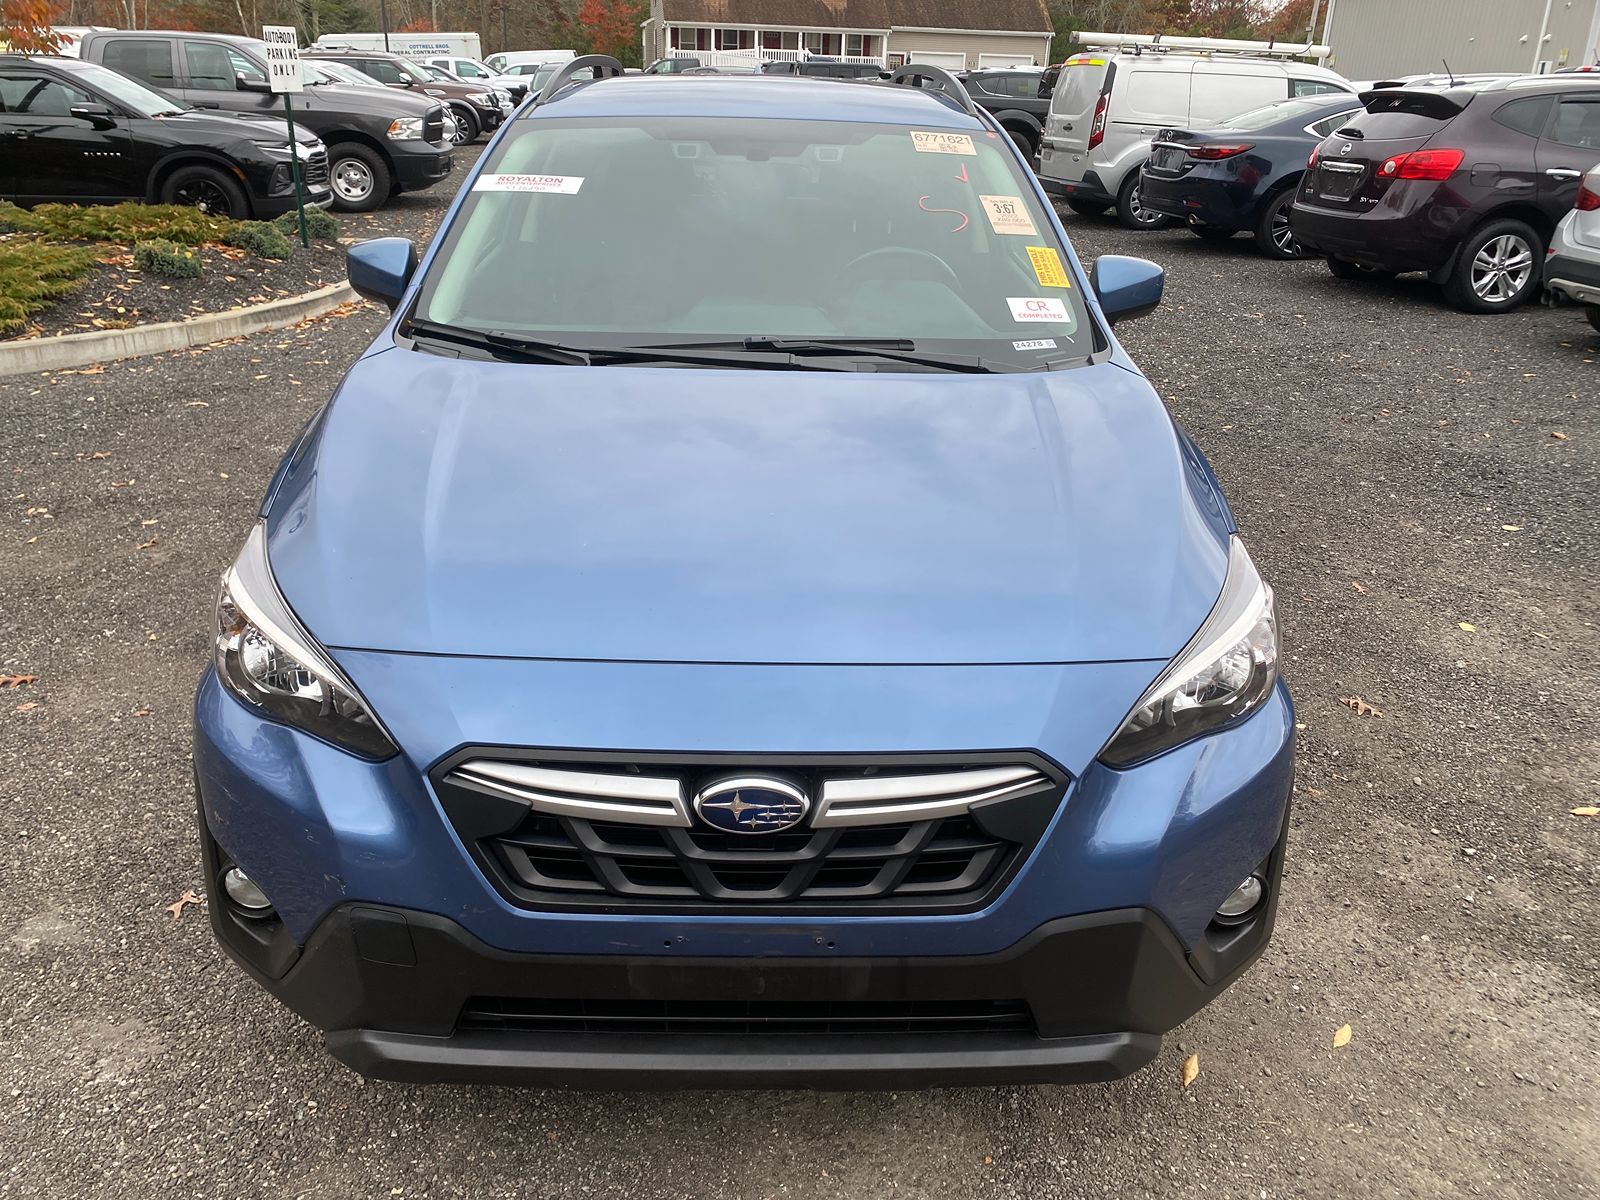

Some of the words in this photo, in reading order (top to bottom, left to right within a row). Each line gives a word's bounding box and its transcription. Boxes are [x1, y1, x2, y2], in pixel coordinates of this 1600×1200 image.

[267, 48, 297, 60] PARKING
[273, 64, 296, 76] ONLY
[914, 133, 971, 145] 6771621
[497, 176, 564, 184] ROYALTON
[993, 203, 1016, 214] 3:67
[1026, 300, 1050, 312] CR
